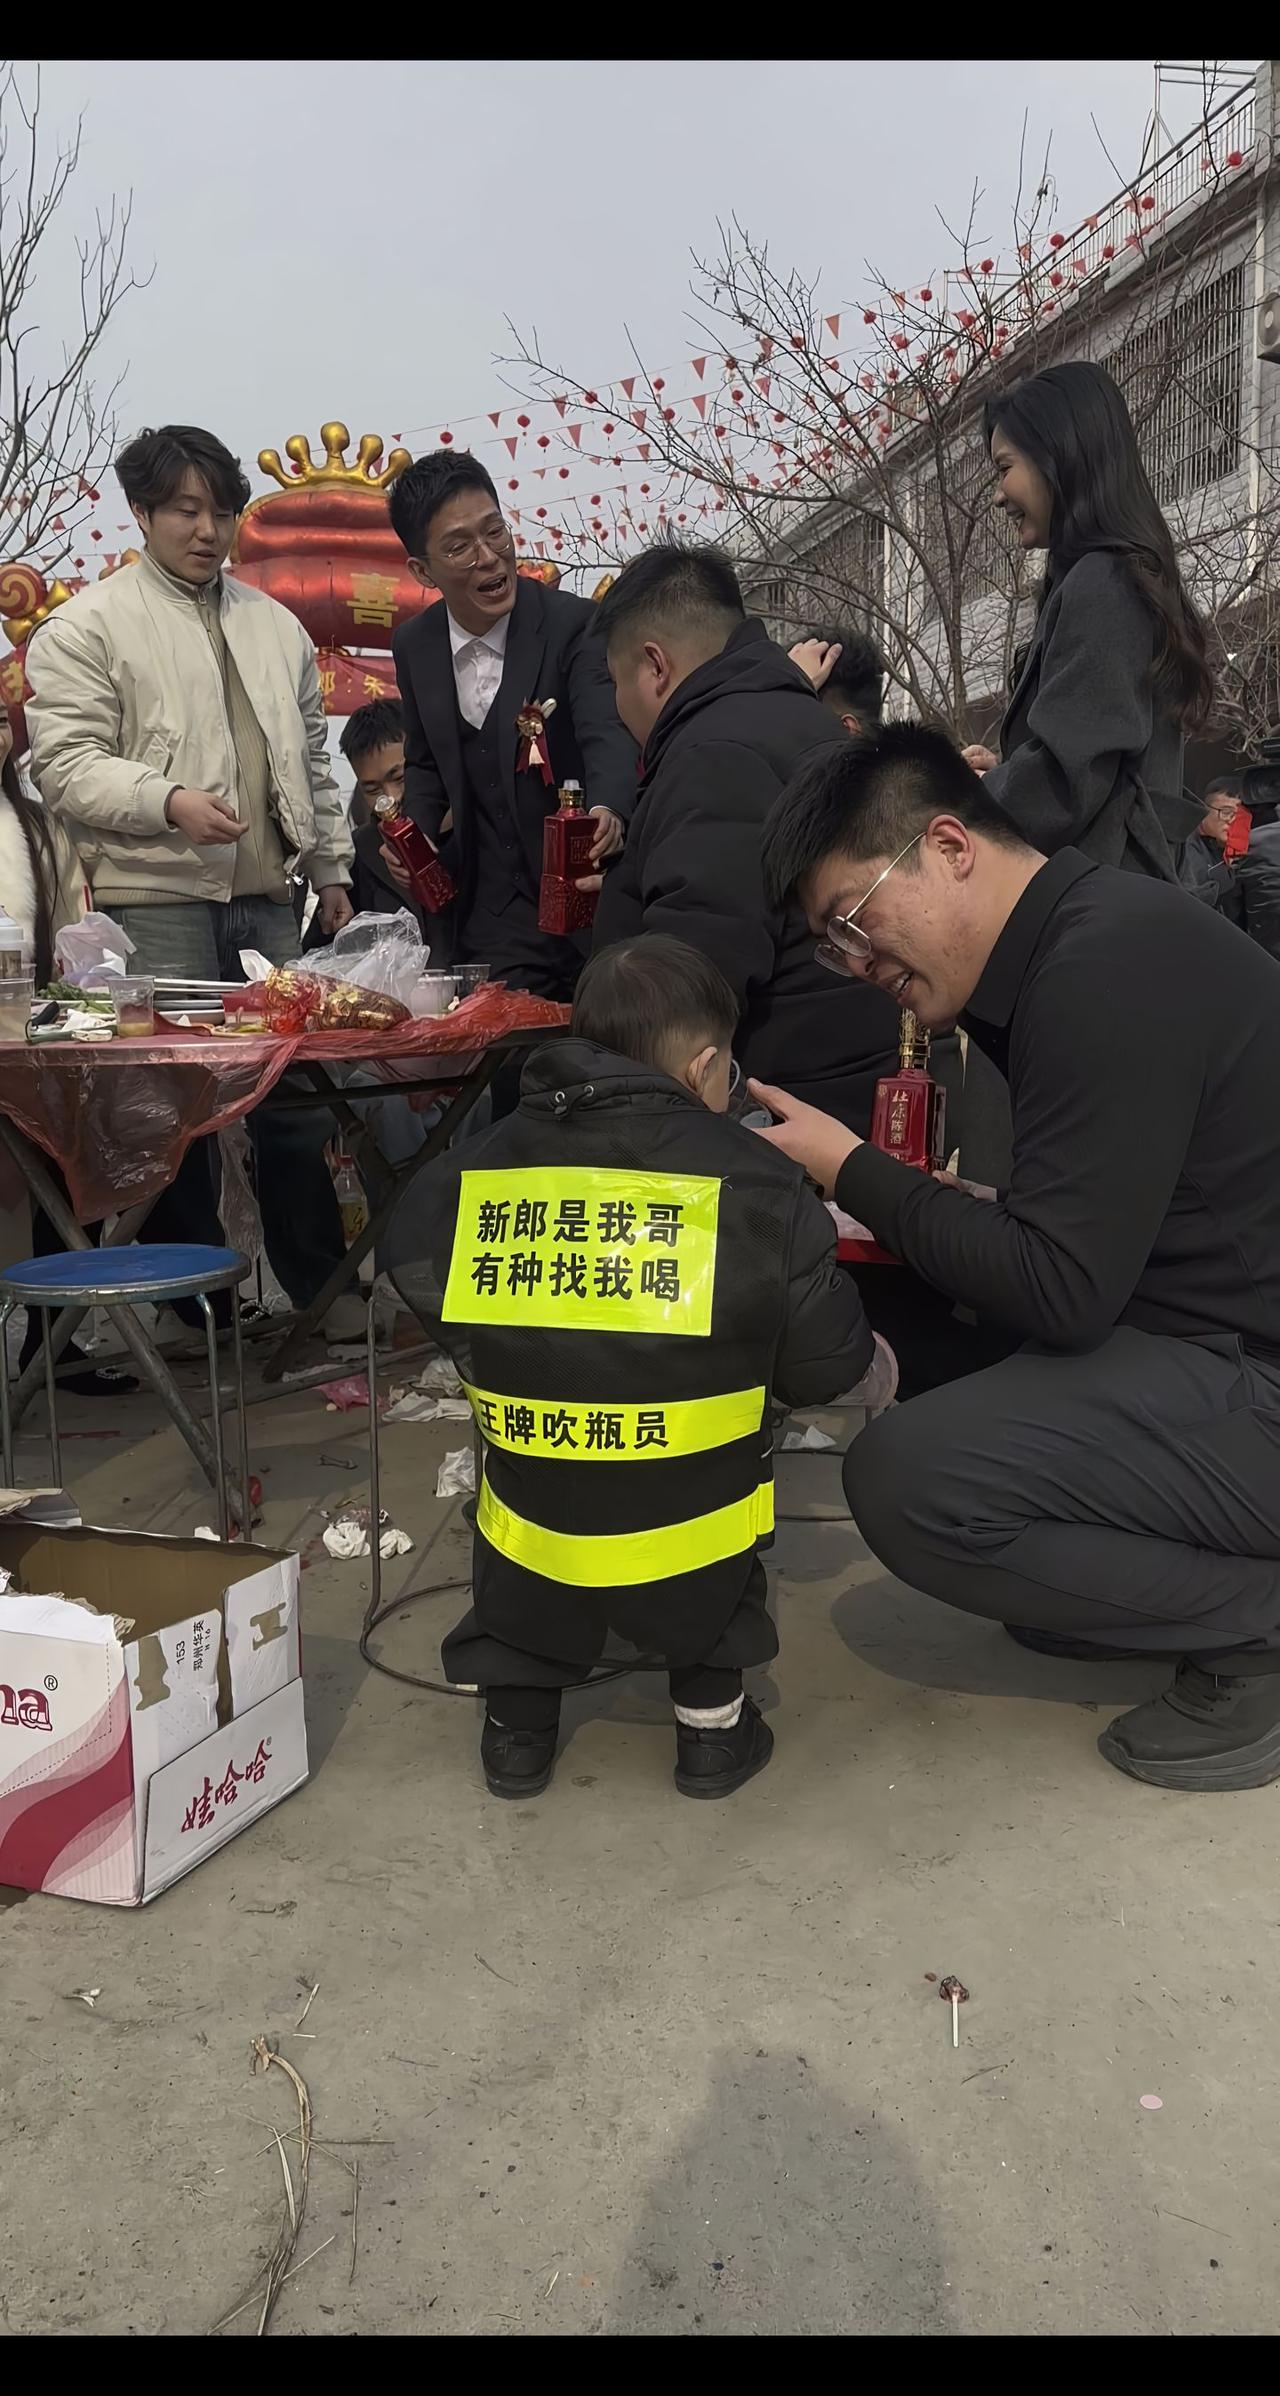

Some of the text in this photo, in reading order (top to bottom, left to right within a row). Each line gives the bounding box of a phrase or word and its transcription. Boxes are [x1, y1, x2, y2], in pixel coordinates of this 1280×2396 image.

[347, 573, 401, 628] 喜
[477, 1199, 684, 1247] 新郎是我哥
[471, 1252, 680, 1302] 有种找我喝
[478, 1398, 669, 1450] 王牌吹瓶员
[176, 1640, 185, 1665] 153
[181, 1739, 272, 1833] 娃哈哈
